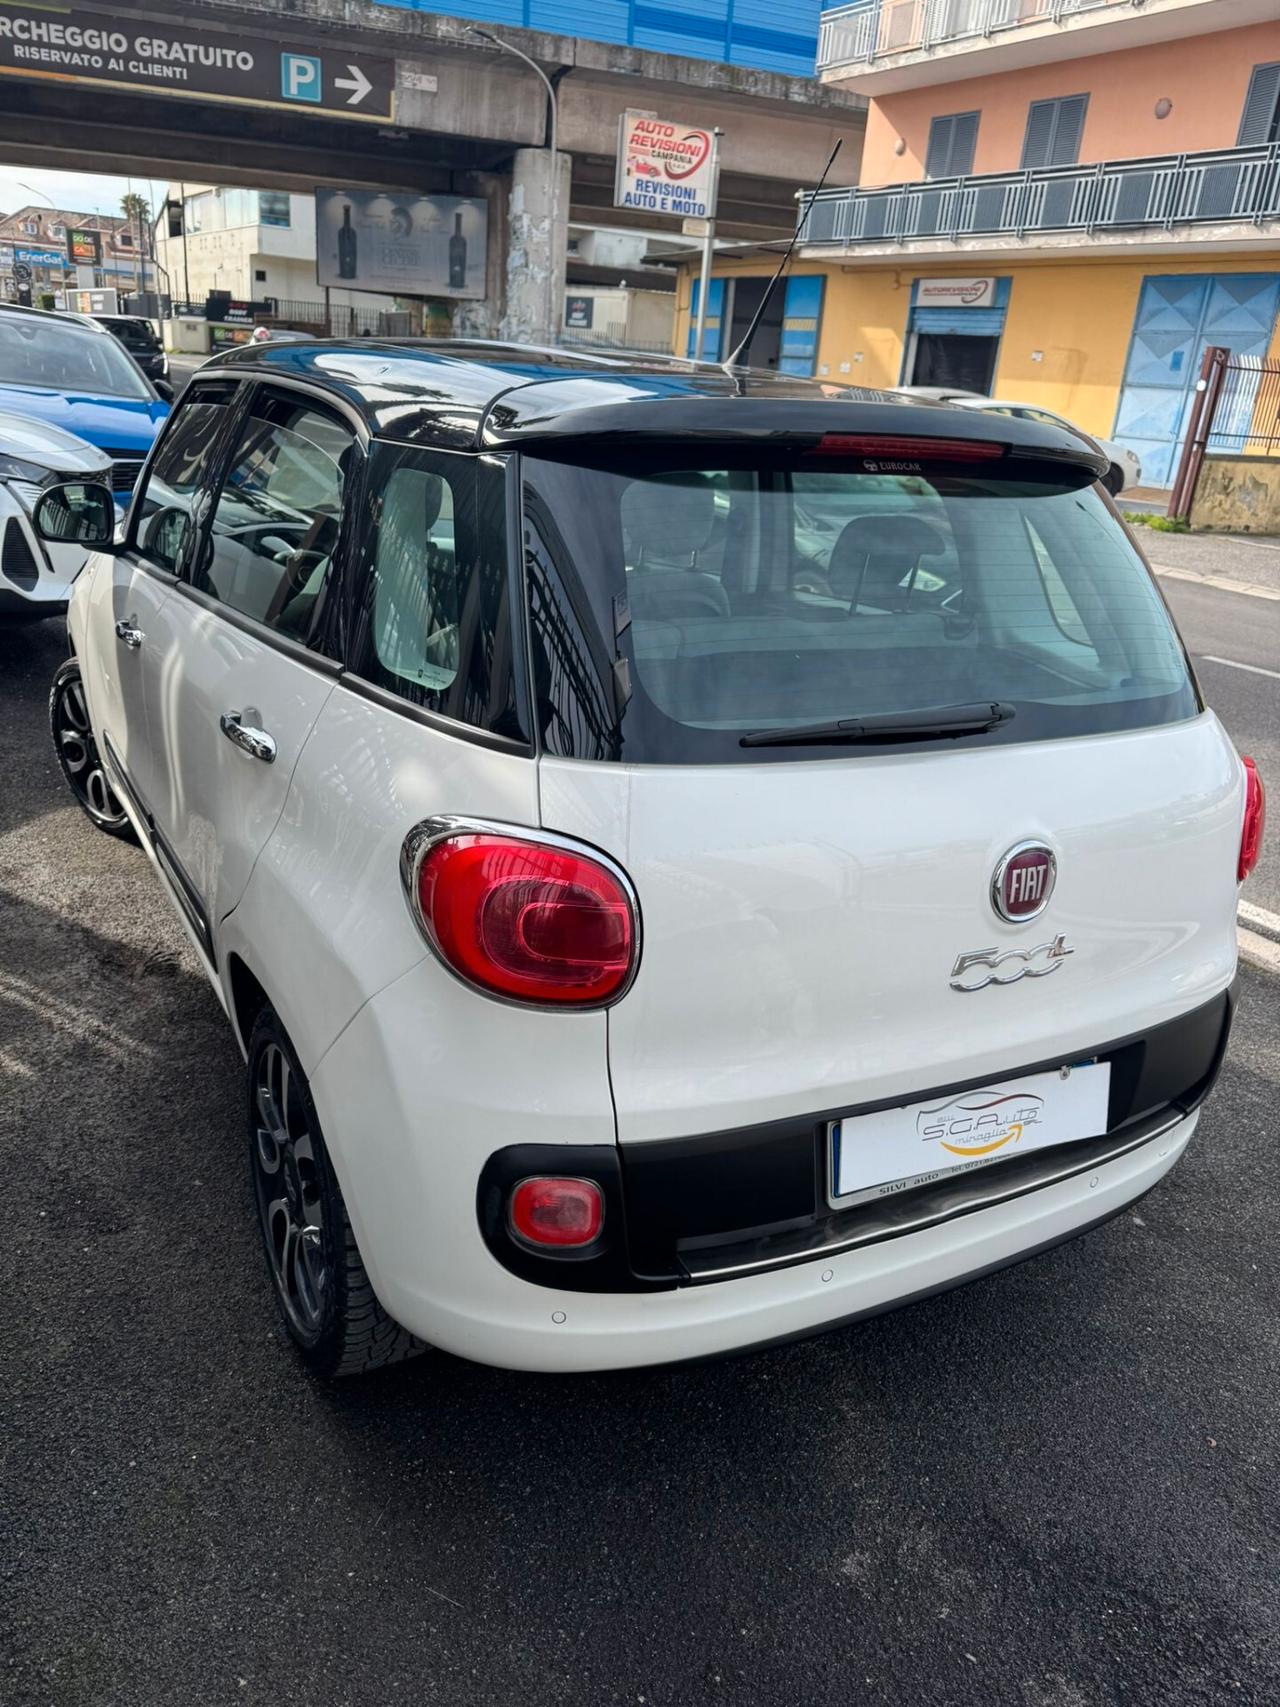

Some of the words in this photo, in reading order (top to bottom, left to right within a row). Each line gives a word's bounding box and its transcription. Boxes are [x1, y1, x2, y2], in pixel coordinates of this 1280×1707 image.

[13, 44, 103, 68] RISERVATO
[107, 58, 124, 71] AI
[128, 61, 187, 80] CLIENTI
[134, 37, 254, 71] GRATUITO
[289, 57, 315, 95] P
[635, 120, 675, 137] AUTO
[630, 134, 701, 157] REVISIONI
[651, 150, 693, 164] CAMPANIA
[636, 179, 697, 200] REVISIONI
[625, 192, 656, 208] AUTO
[661, 199, 668, 210] E
[672, 201, 705, 216] MOTO
[880, 461, 922, 472] EUROCAR
[1009, 865, 1047, 905] FIAT
[913, 1172, 939, 1185] auto
